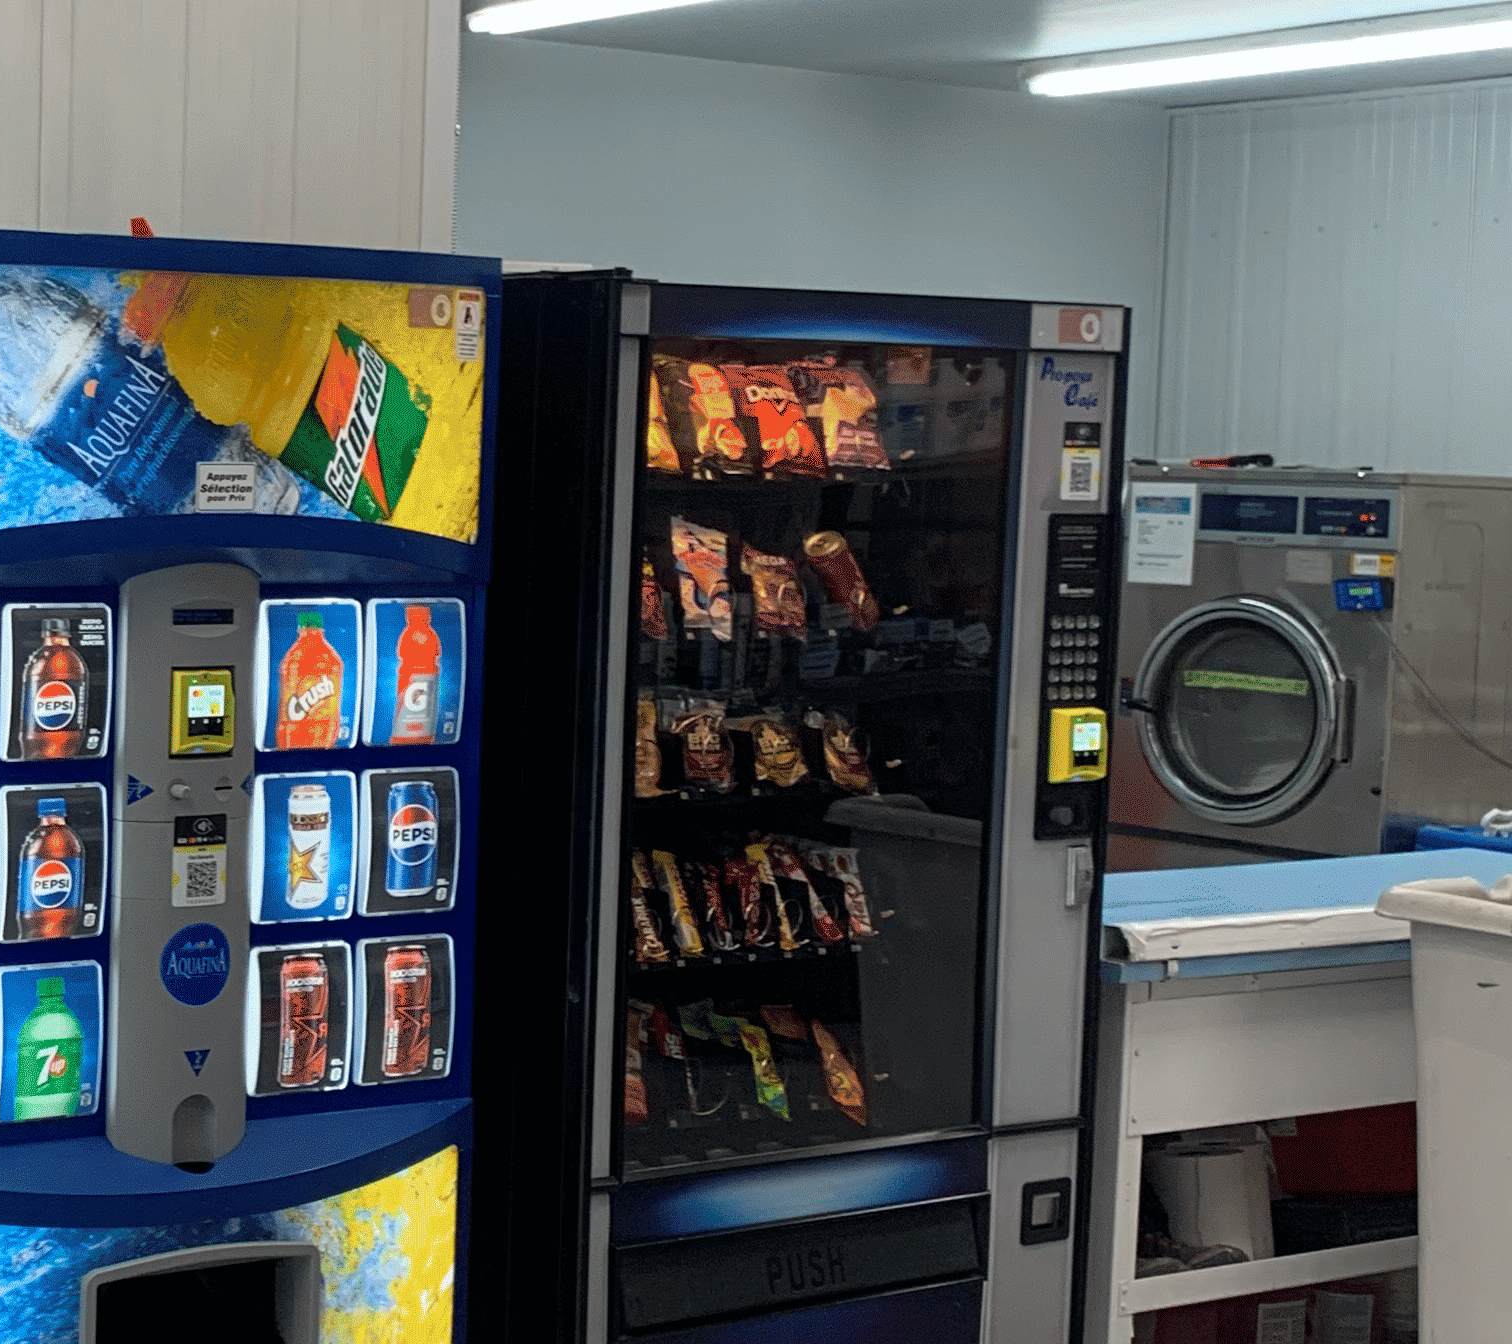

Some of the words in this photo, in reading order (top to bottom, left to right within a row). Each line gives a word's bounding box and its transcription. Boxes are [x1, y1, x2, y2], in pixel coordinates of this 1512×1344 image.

[66, 355, 166, 477] AQUAFINA
[325, 340, 387, 508] Gatorade
[206, 472, 248, 482] Appuyez
[200, 484, 253, 494] Sélection
[37, 701, 74, 712] PEPSI
[287, 674, 336, 722] Crush
[392, 829, 436, 842] PEPSI
[34, 879, 70, 890] PEPSI
[167, 949, 226, 979] AQUAFINA
[766, 1247, 846, 1294] PUSH
